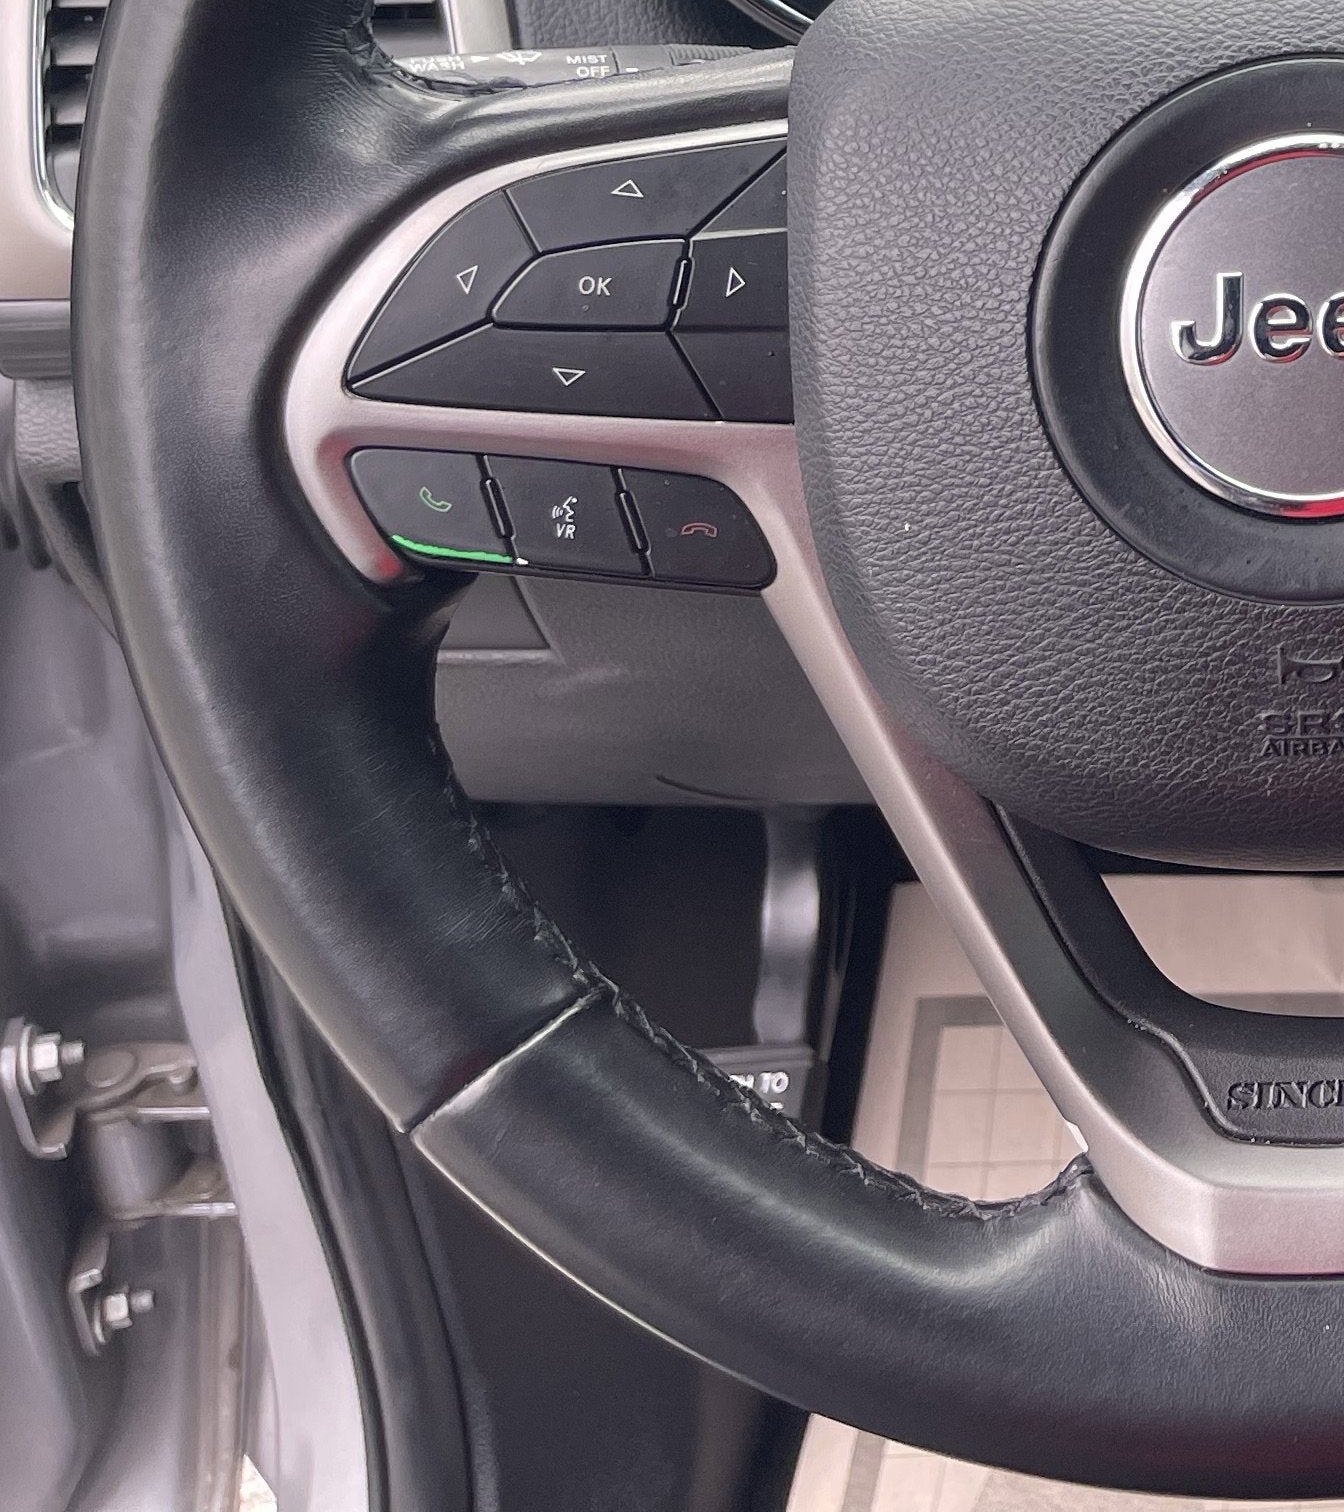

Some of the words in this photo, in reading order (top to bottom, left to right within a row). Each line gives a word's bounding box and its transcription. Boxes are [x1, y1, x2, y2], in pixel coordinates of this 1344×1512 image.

[566, 54, 608, 65] MIST
[408, 61, 465, 73] WASH
[576, 65, 610, 78] OFF
[578, 275, 613, 296] OK
[556, 523, 576, 539] VR
[760, 1071, 790, 1094] TO
